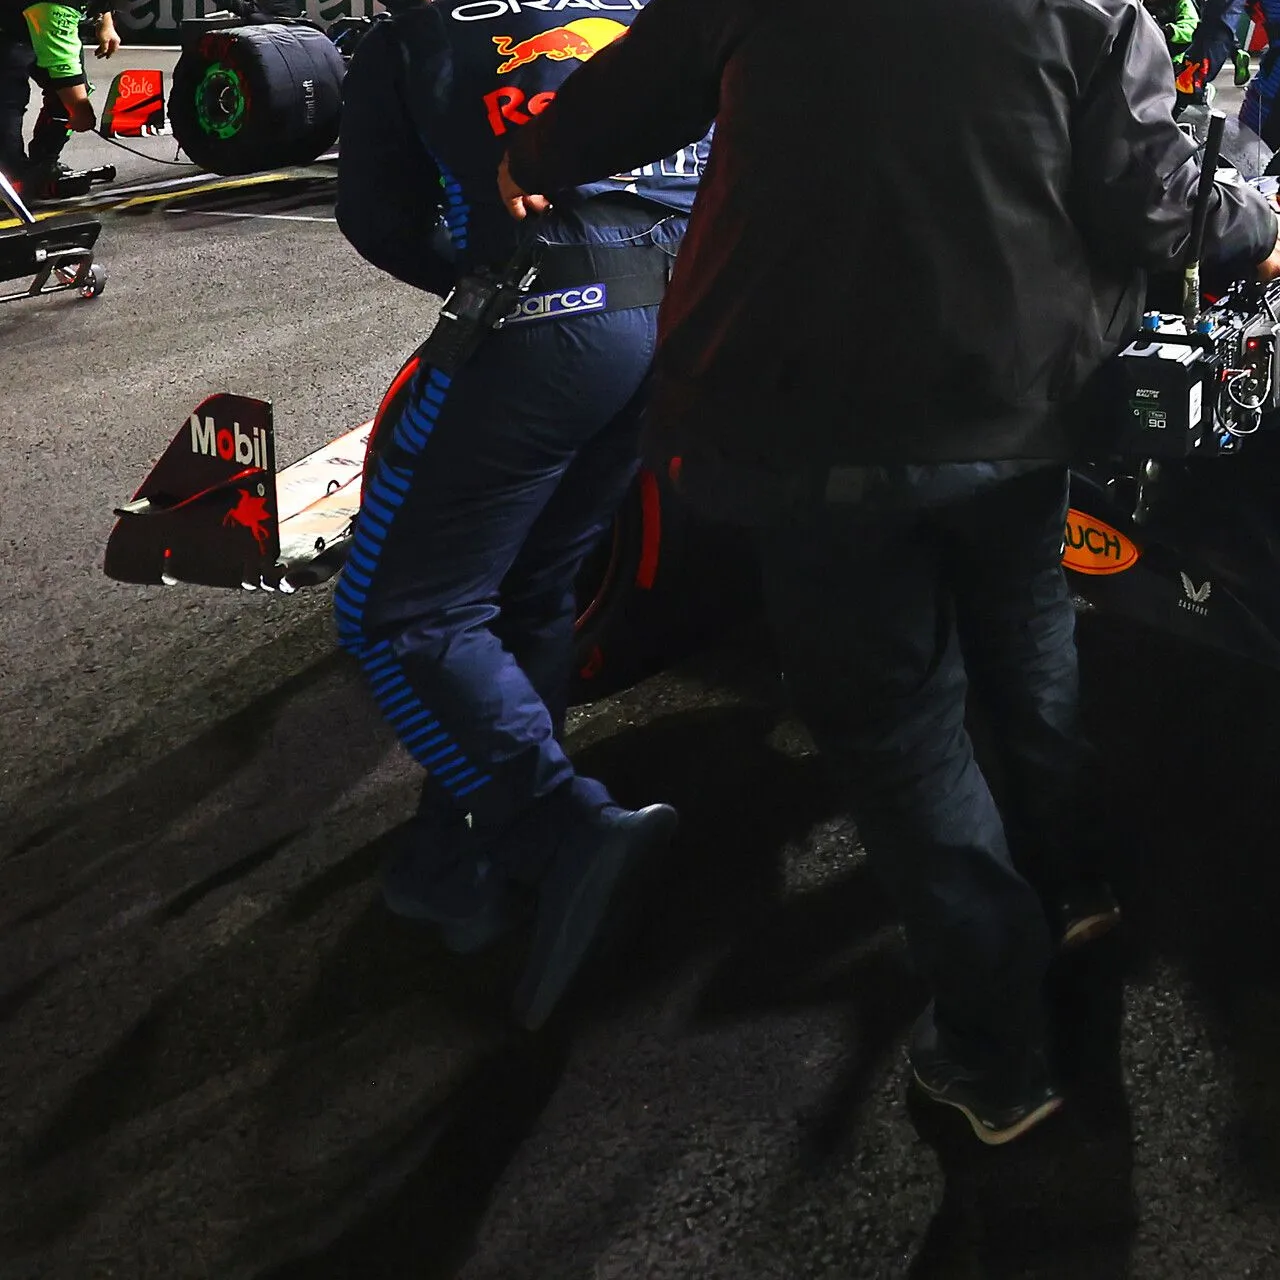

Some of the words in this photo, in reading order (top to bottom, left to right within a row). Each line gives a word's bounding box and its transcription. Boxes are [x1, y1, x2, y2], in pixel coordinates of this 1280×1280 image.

[119, 74, 153, 99] Stake
[302, 79, 314, 98] Left
[1148, 419, 1166, 429] 90
[190, 415, 268, 470] Mobil
